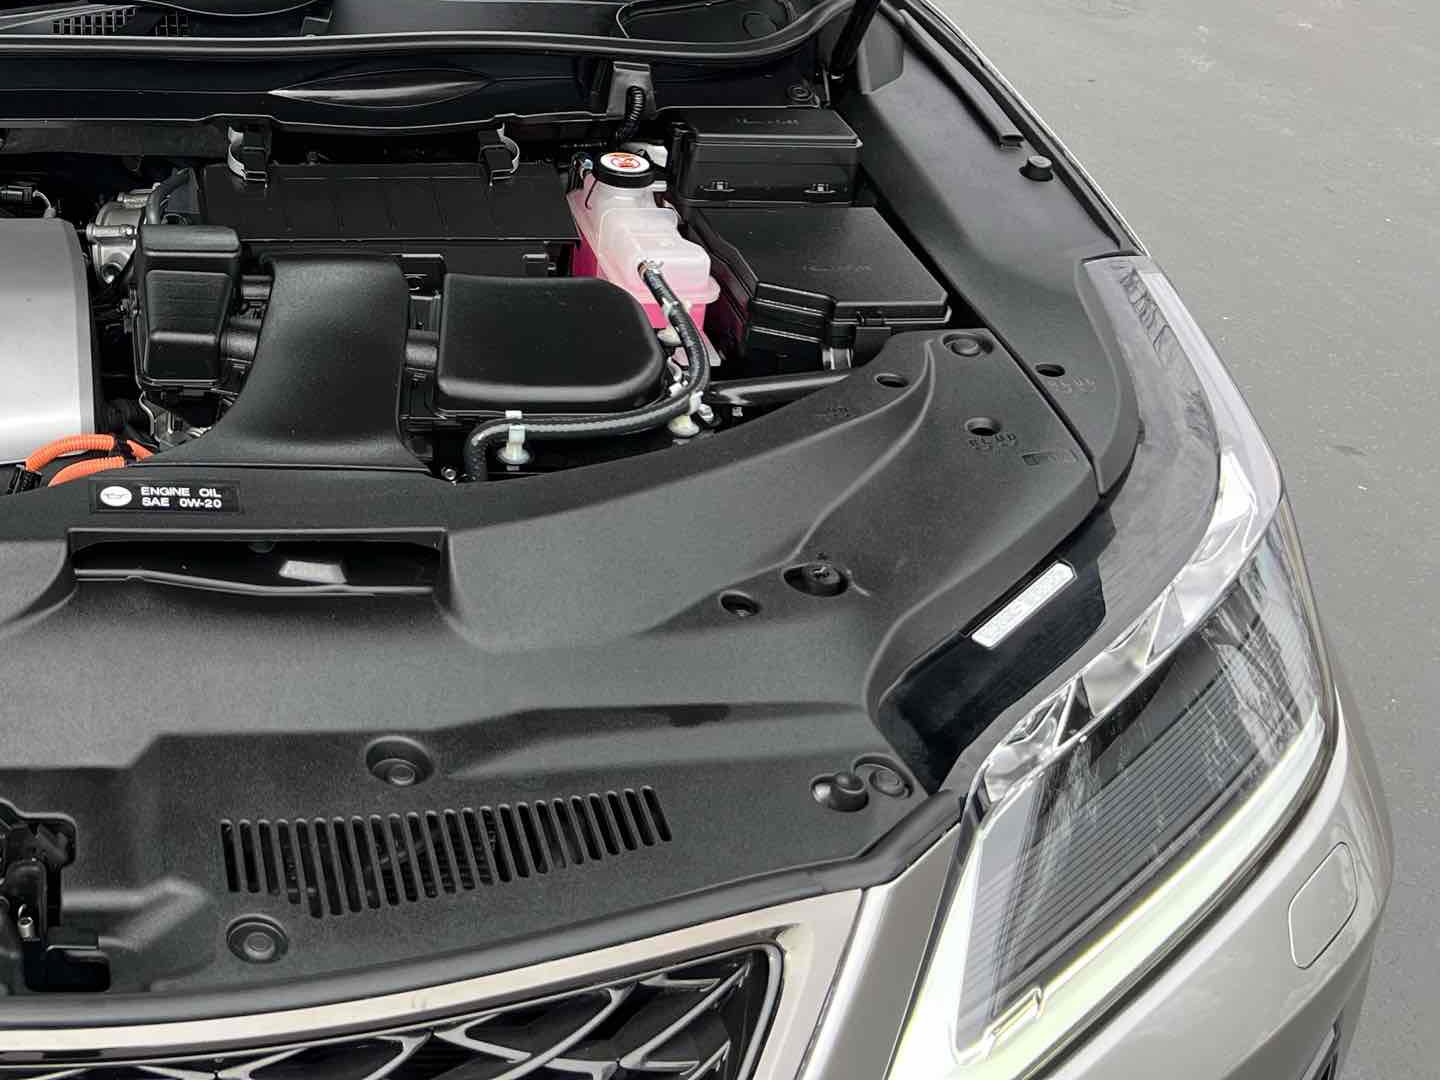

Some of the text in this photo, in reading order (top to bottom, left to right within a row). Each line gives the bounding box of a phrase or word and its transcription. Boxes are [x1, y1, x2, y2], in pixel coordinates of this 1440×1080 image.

[140, 486, 222, 498] ENGINE OIL
[141, 497, 222, 508] SAE 0W-20
